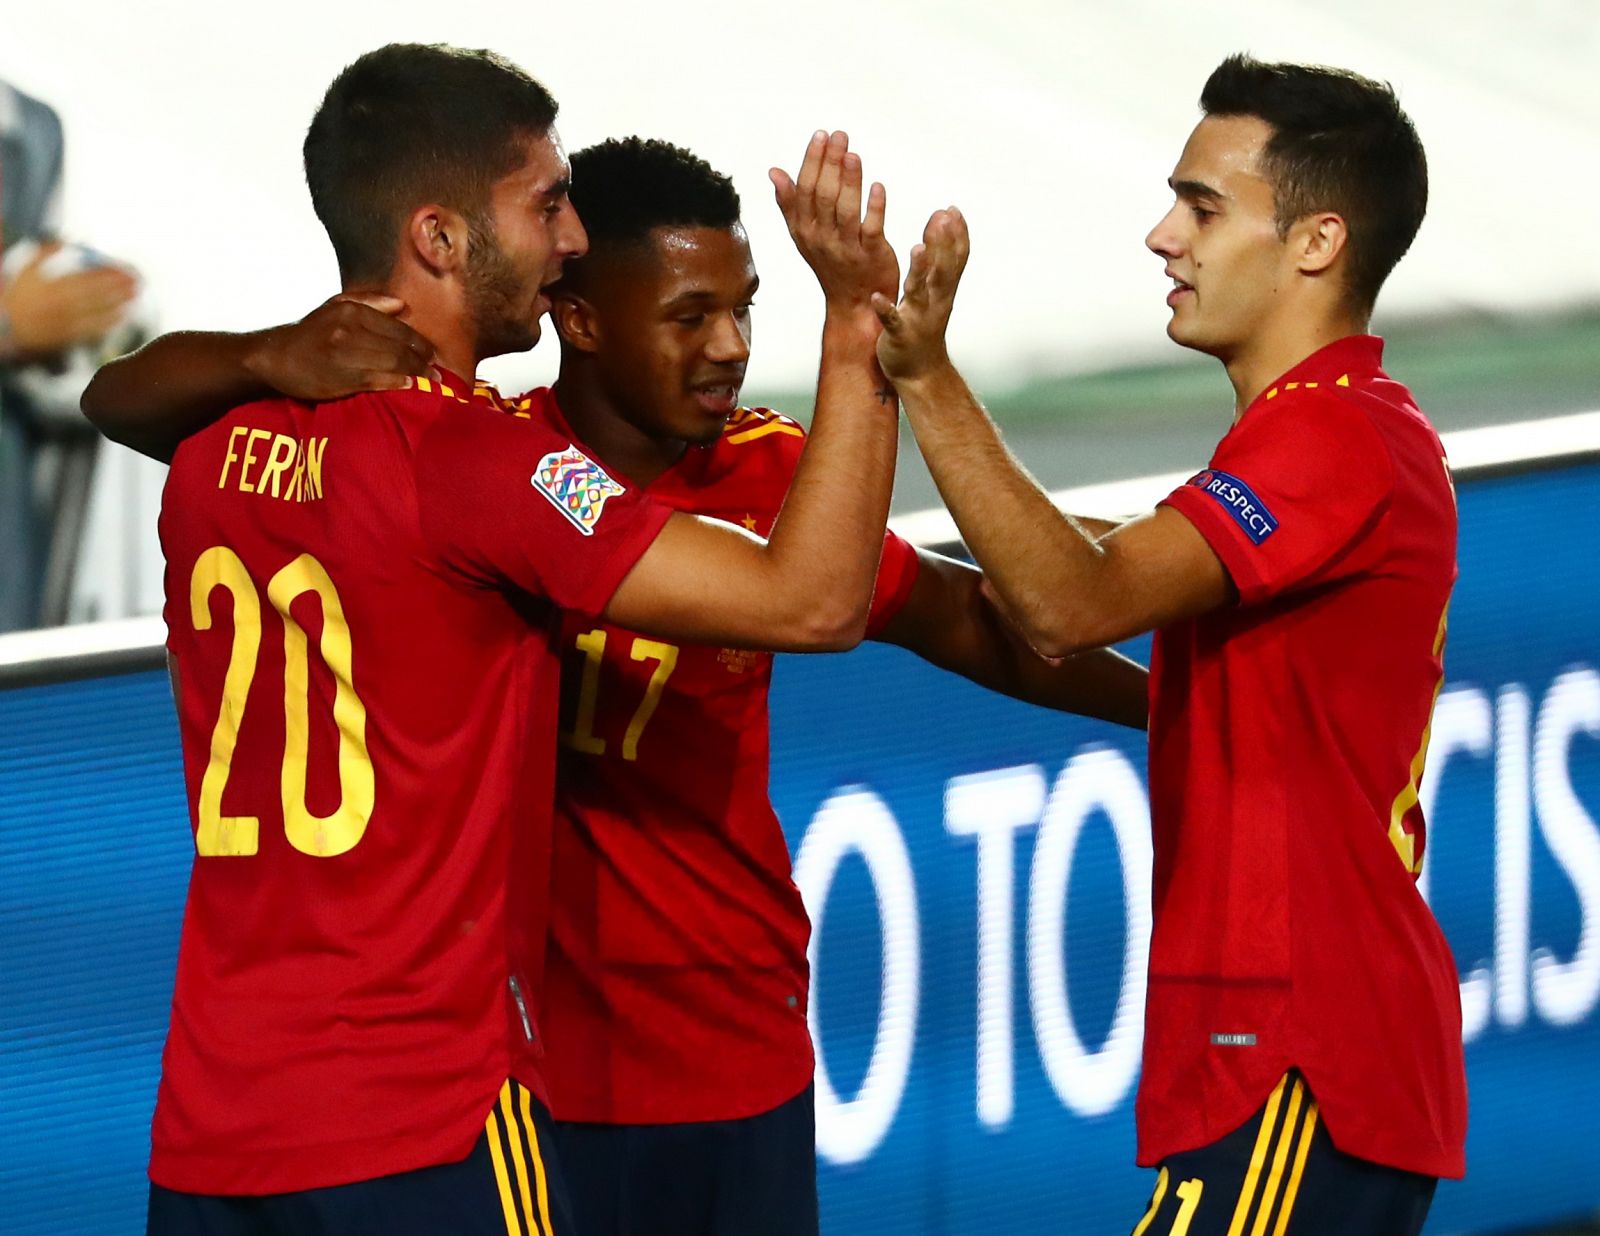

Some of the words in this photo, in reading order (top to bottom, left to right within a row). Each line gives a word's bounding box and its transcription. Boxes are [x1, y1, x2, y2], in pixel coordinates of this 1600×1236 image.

[1207, 478, 1272, 536] RESPECT
[190, 546, 375, 857] 20
[563, 629, 679, 761] 17
[945, 743, 1153, 1130] TO
